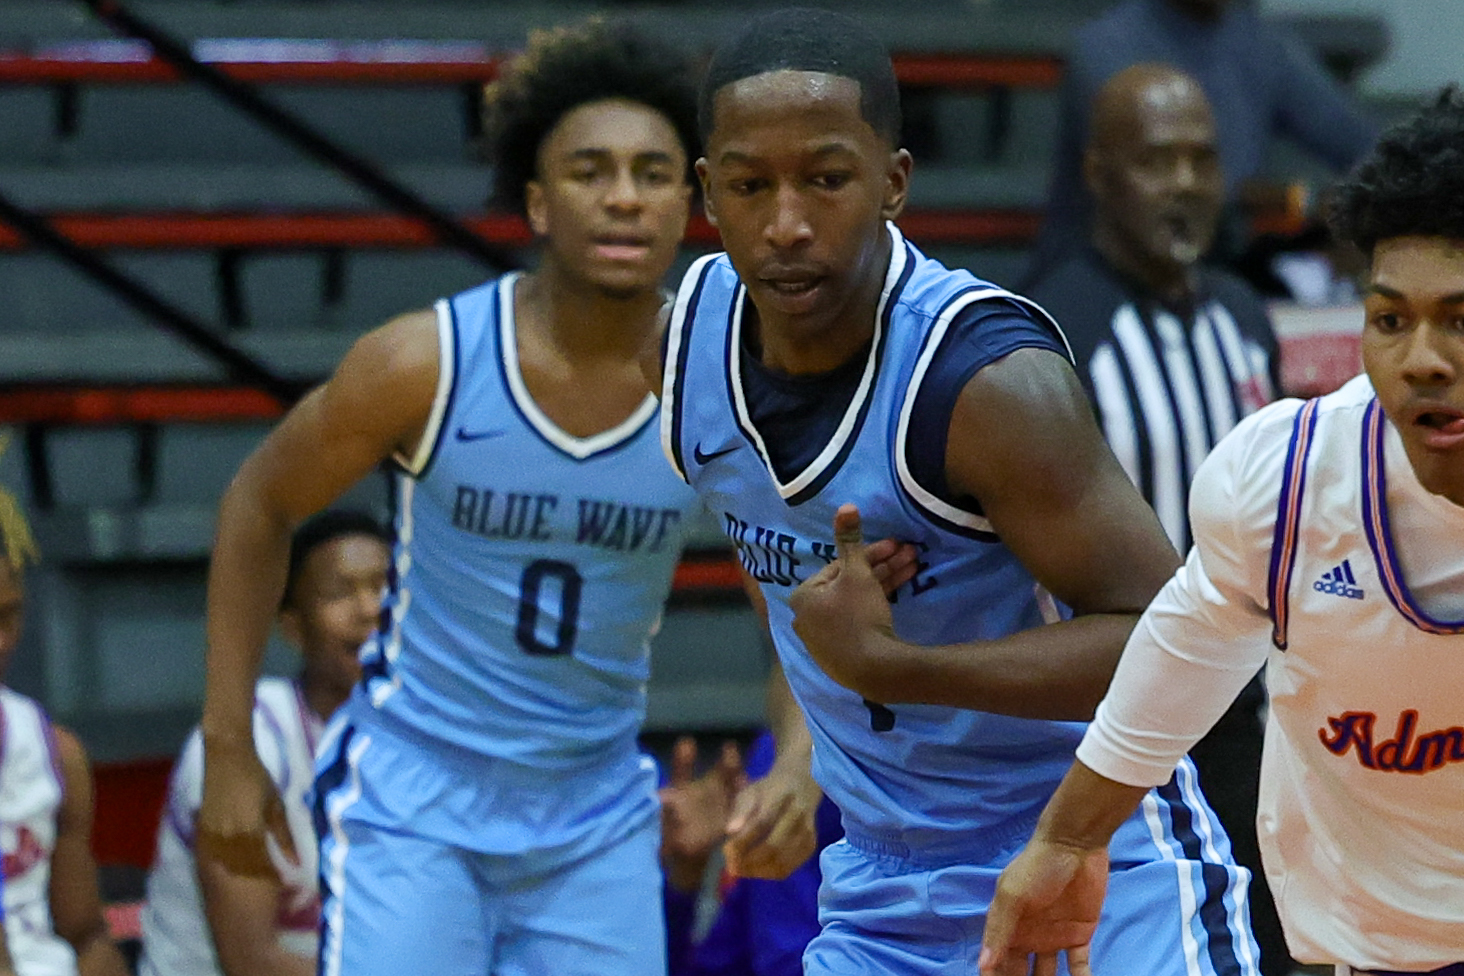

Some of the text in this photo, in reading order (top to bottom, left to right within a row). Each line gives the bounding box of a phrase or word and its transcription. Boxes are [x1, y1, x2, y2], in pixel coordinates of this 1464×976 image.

[452, 485, 681, 553] BLUE WAVE
[516, 558, 582, 656] 0
[1313, 580, 1365, 600] adidas
